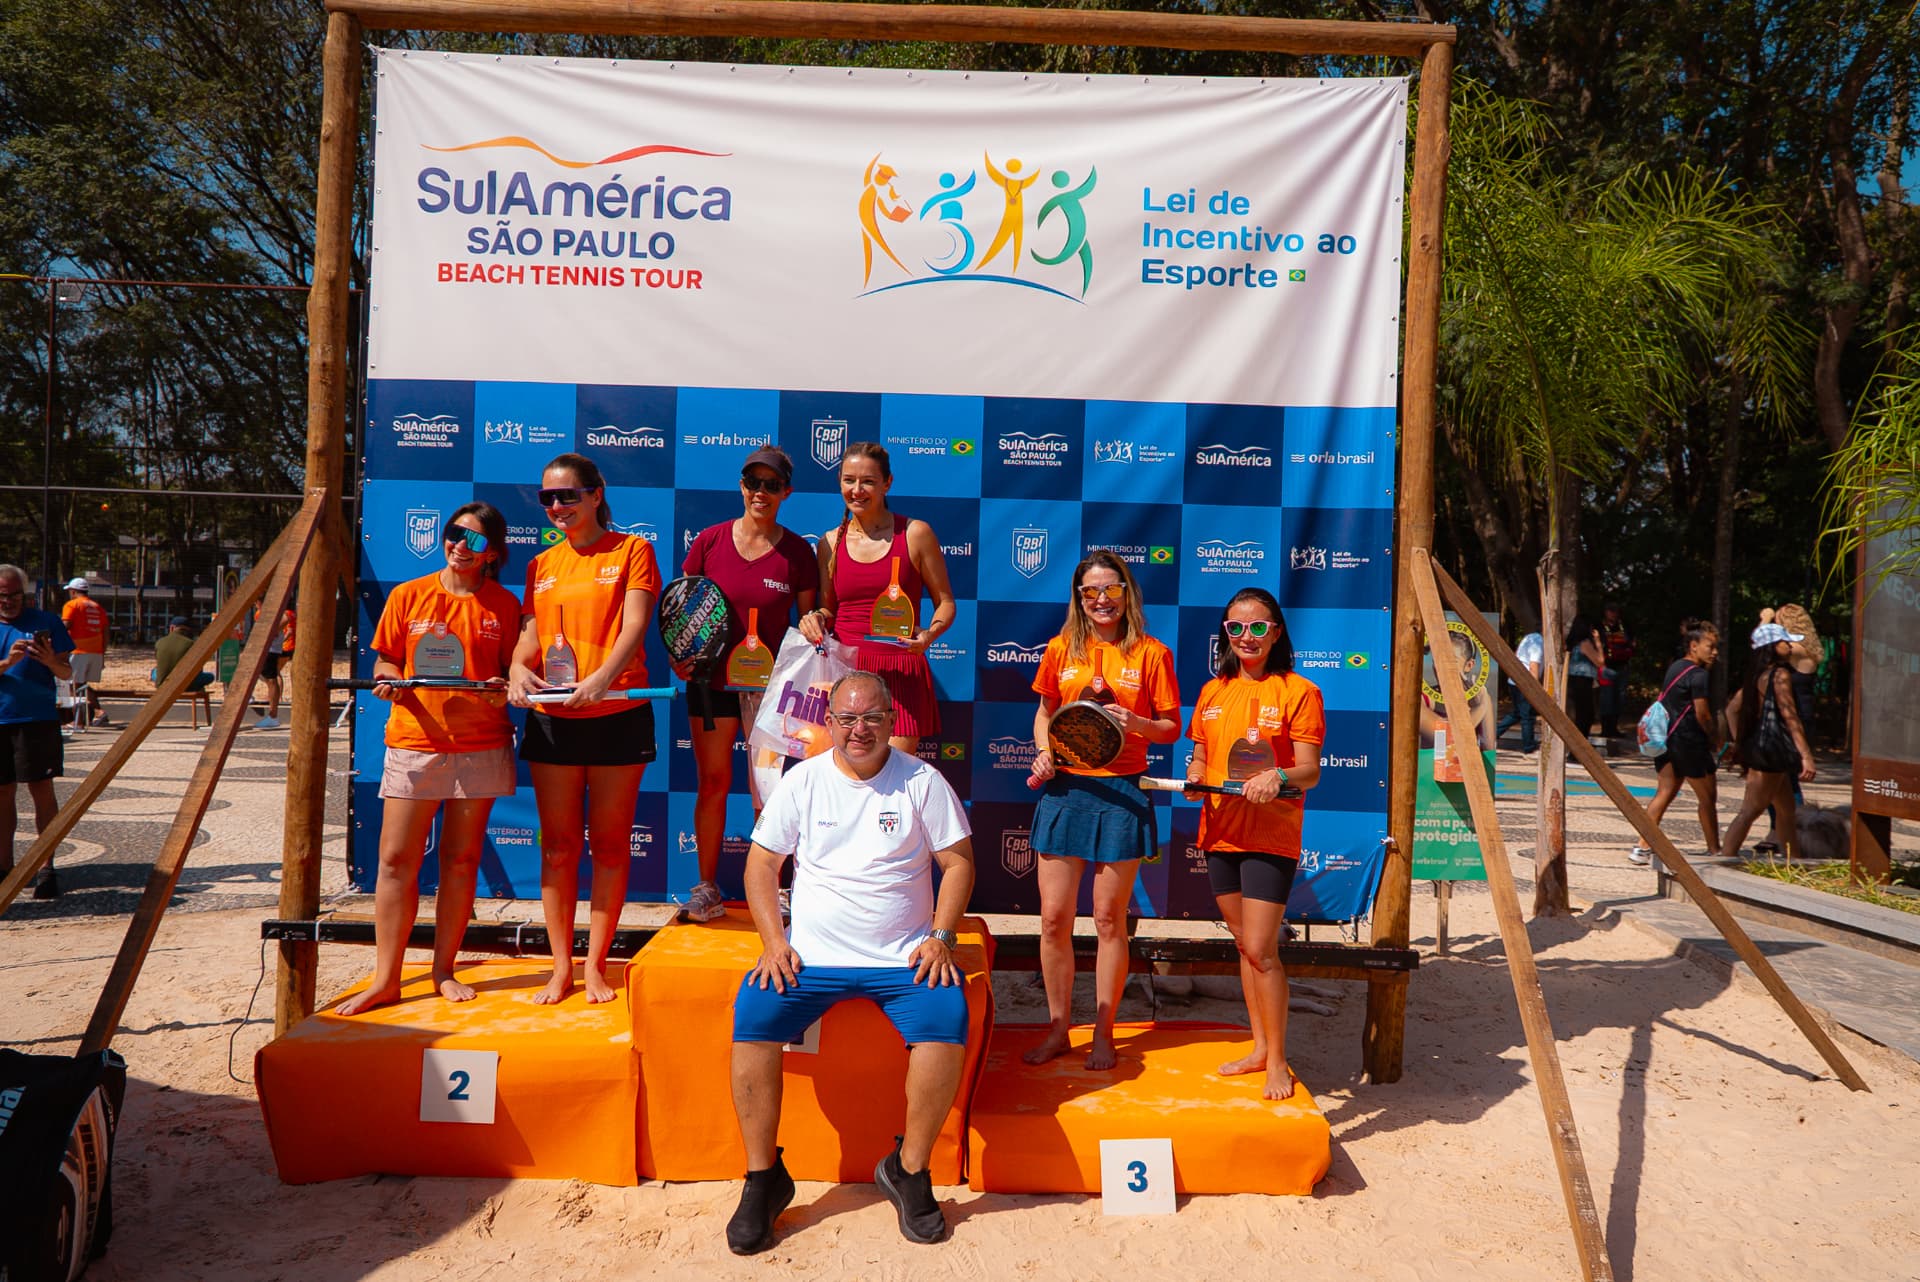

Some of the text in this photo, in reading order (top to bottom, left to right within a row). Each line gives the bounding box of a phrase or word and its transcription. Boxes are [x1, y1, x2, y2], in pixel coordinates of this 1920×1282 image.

[417, 167, 732, 221] SulAmérica
[1143, 187, 1250, 215] Lei de
[467, 220, 675, 260] SÃO PAULO
[1142, 222, 1357, 255] Incentivo ao
[438, 263, 702, 289] BEACH TENNIS TOUR
[1141, 259, 1278, 290] Esporte
[392, 420, 460, 433] SulAmérica
[403, 431, 448, 441] SÃO PAULO
[586, 433, 664, 448] SulAmérica
[702, 433, 770, 446] orla brasil
[815, 426, 844, 442] CBBT
[935, 438, 947, 446] DO
[998, 438, 1068, 452] SulAmérica
[908, 447, 946, 455] ESPORTE
[1010, 450, 1056, 460] SÃO PAULO
[1308, 451, 1374, 464] orla brasil
[1196, 452, 1272, 466] SulAmérica
[409, 515, 438, 531] CBBT
[526, 527, 538, 535] DO
[504, 536, 537, 544] SPORTE
[1016, 535, 1044, 550] CBBT
[940, 543, 972, 556] rasil
[1134, 546, 1147, 554] DO
[1196, 547, 1264, 559] SulAmérica
[1226, 560, 1252, 568] PAULO
[987, 649, 1044, 663] SulAmér
[1329, 651, 1342, 659] DO
[1303, 660, 1340, 668] ESPORTE
[988, 742, 1036, 755] SulAmé
[1330, 754, 1368, 768] brasil
[1414, 818, 1440, 828] com
[1443, 819, 1450, 828] a
[520, 828, 533, 836] DO
[496, 837, 532, 846] ESPORTE
[1006, 836, 1030, 851] CBB
[448, 1070, 470, 1100] 2
[1127, 1160, 1148, 1192] 3
